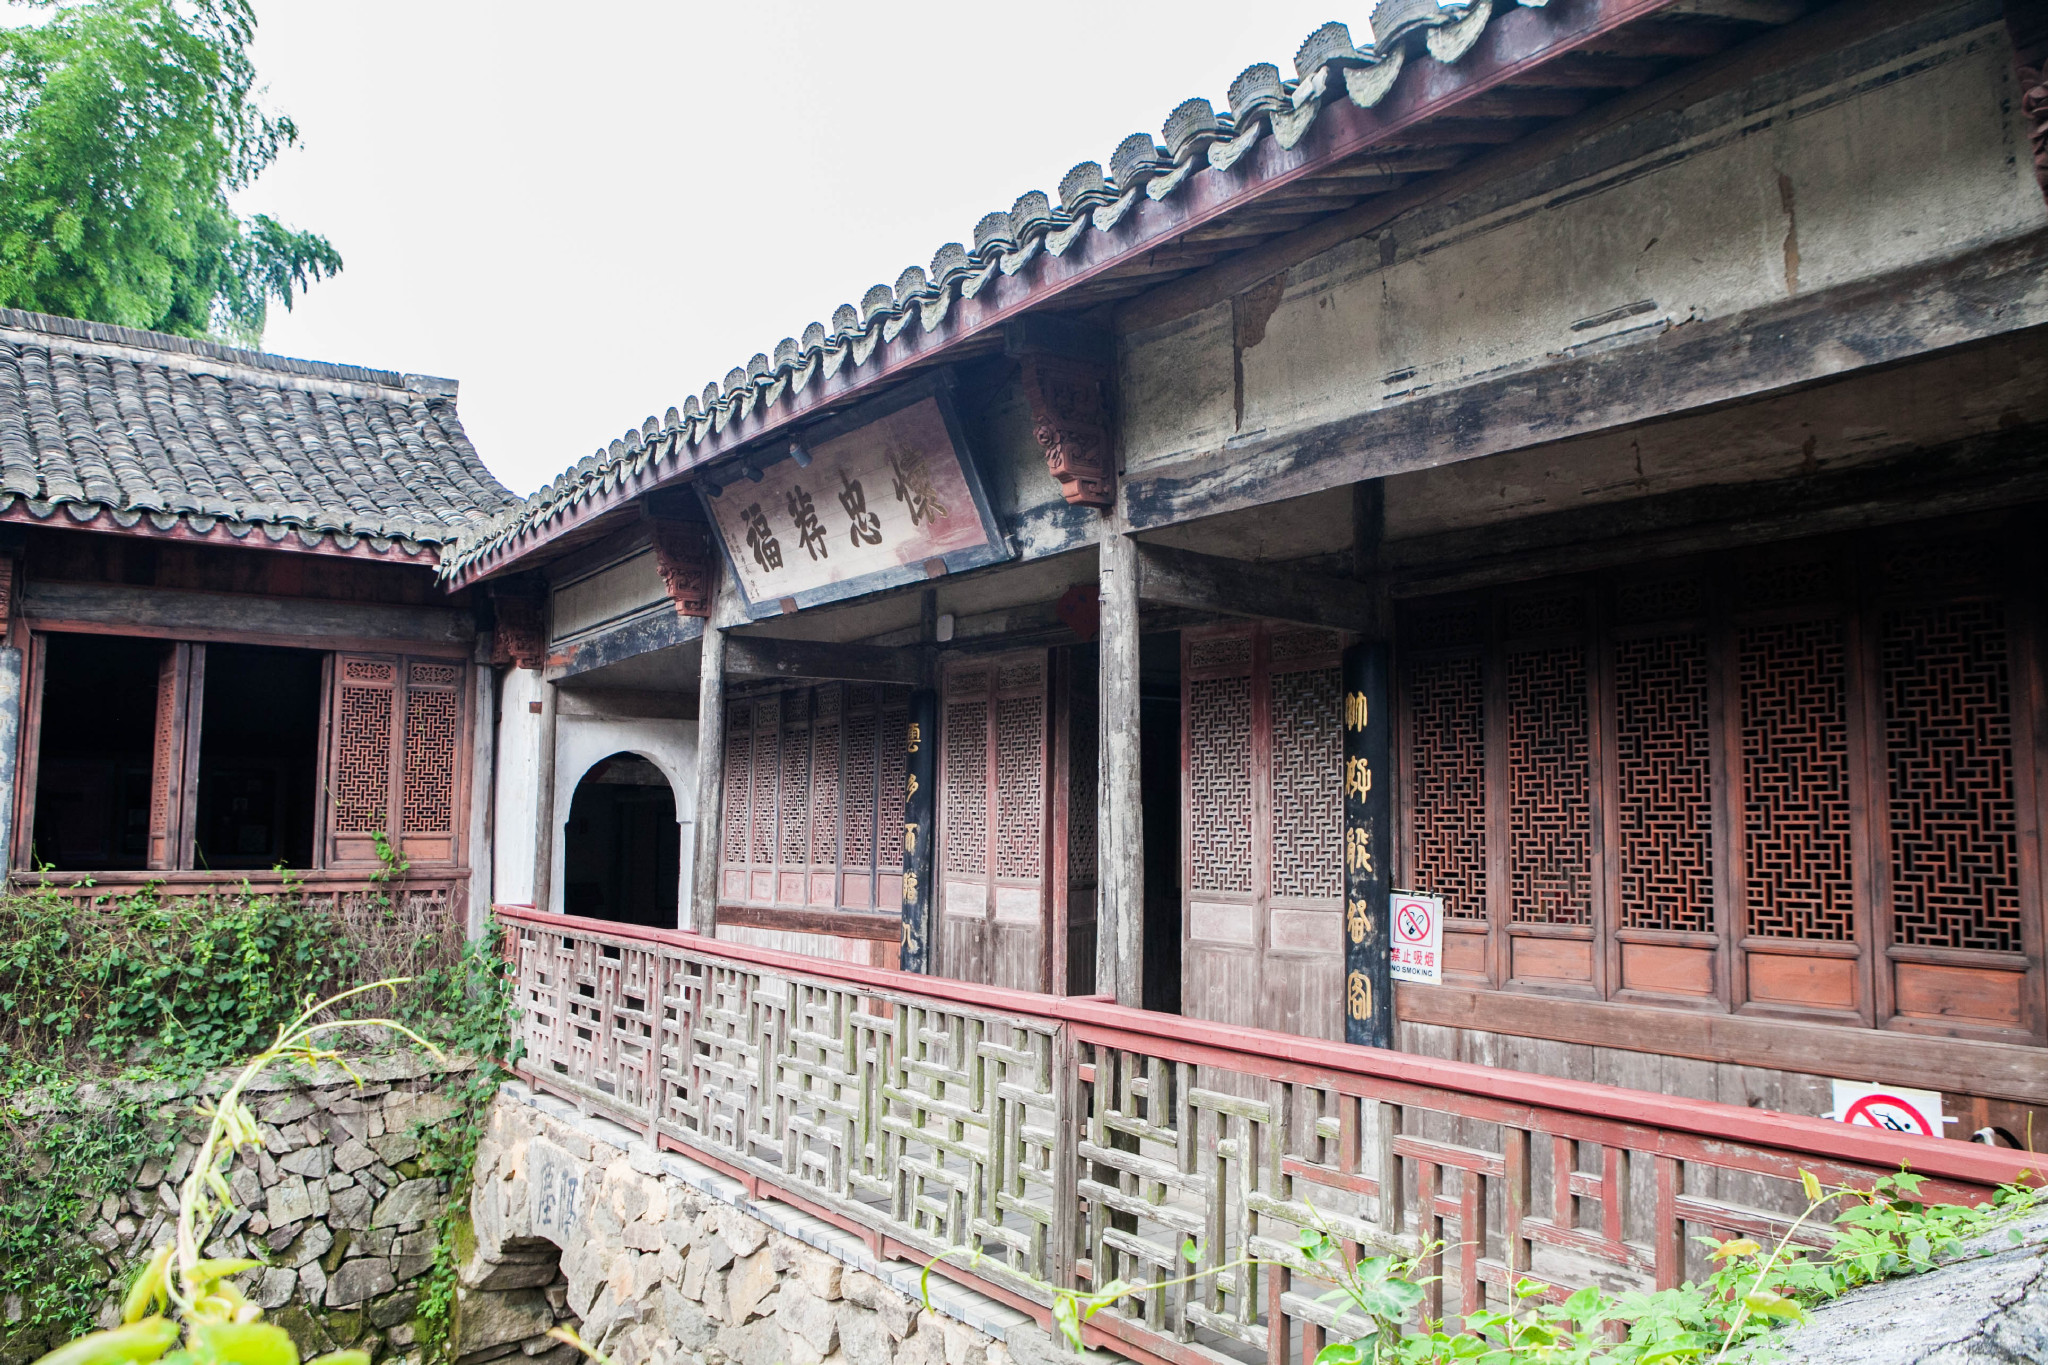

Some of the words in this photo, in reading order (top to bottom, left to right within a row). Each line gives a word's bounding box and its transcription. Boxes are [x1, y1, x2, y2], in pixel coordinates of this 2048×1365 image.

[1391, 947, 1434, 967] 禁止吸烟
[1402, 966, 1433, 977] SMOKING
